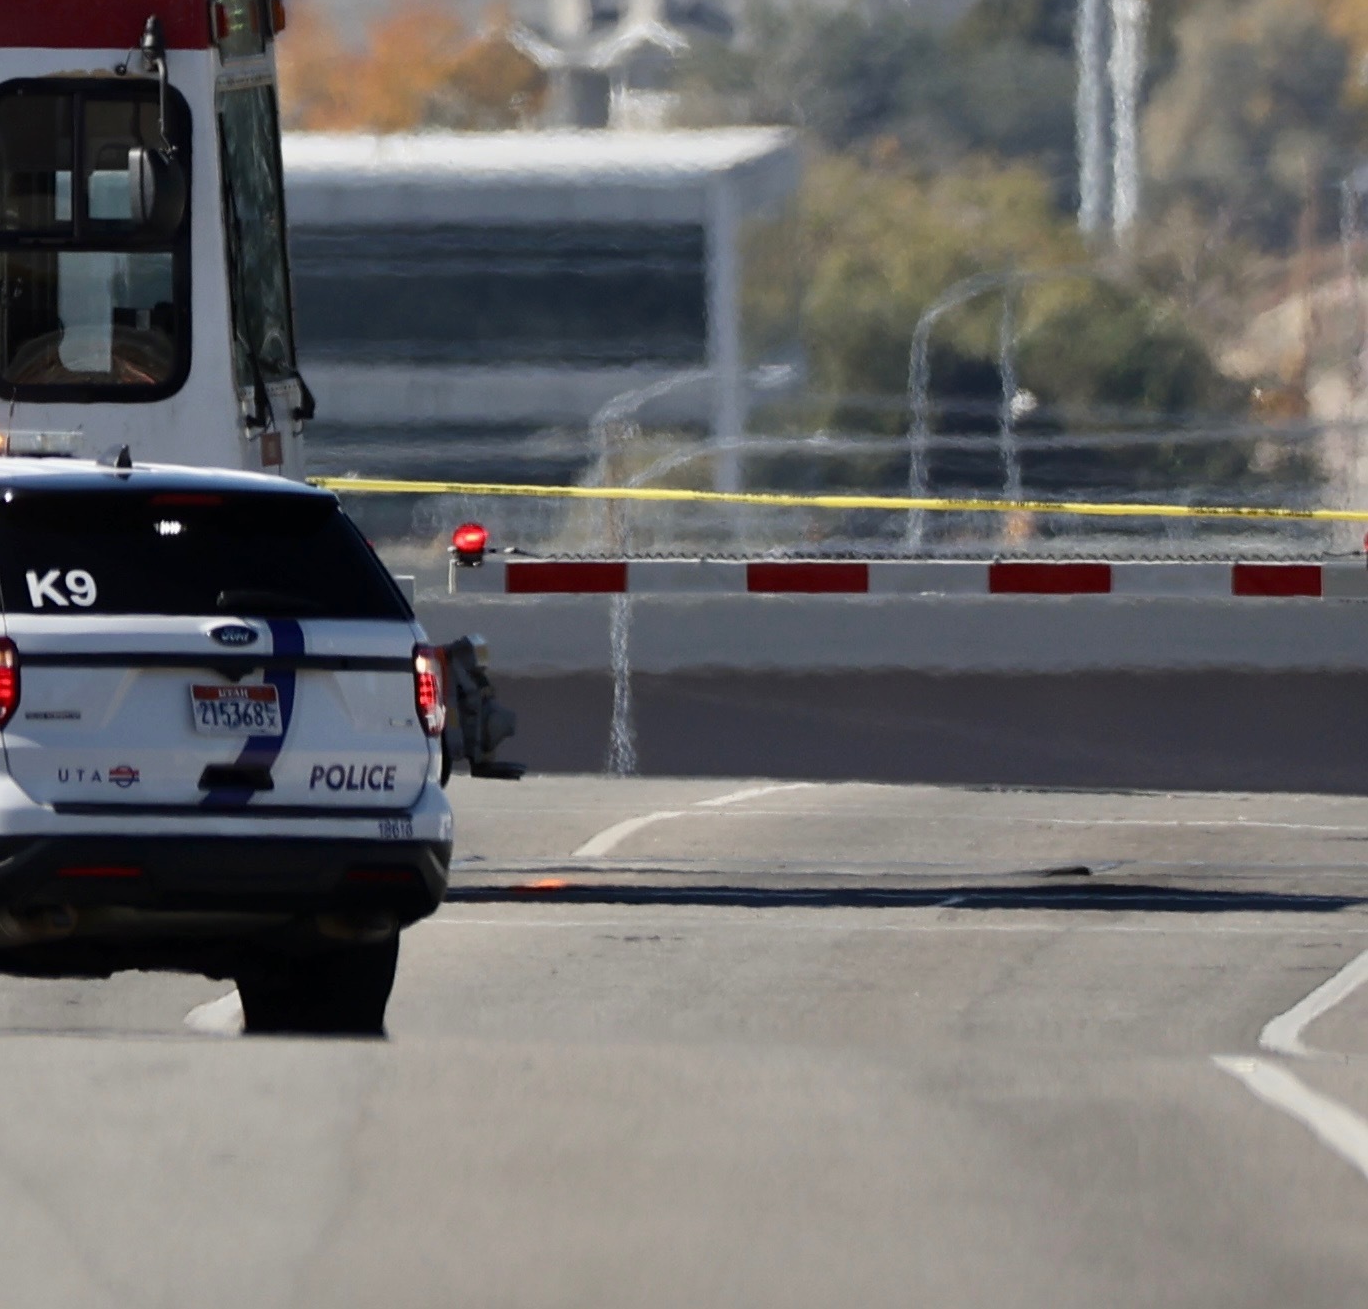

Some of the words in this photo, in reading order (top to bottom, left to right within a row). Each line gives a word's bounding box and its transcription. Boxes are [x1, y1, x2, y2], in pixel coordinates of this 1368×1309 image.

[25, 569, 97, 609] K9
[218, 688, 248, 698] UTAH
[200, 701, 264, 728] 215368
[58, 768, 102, 783] UTA
[309, 764, 397, 791] POLICE
